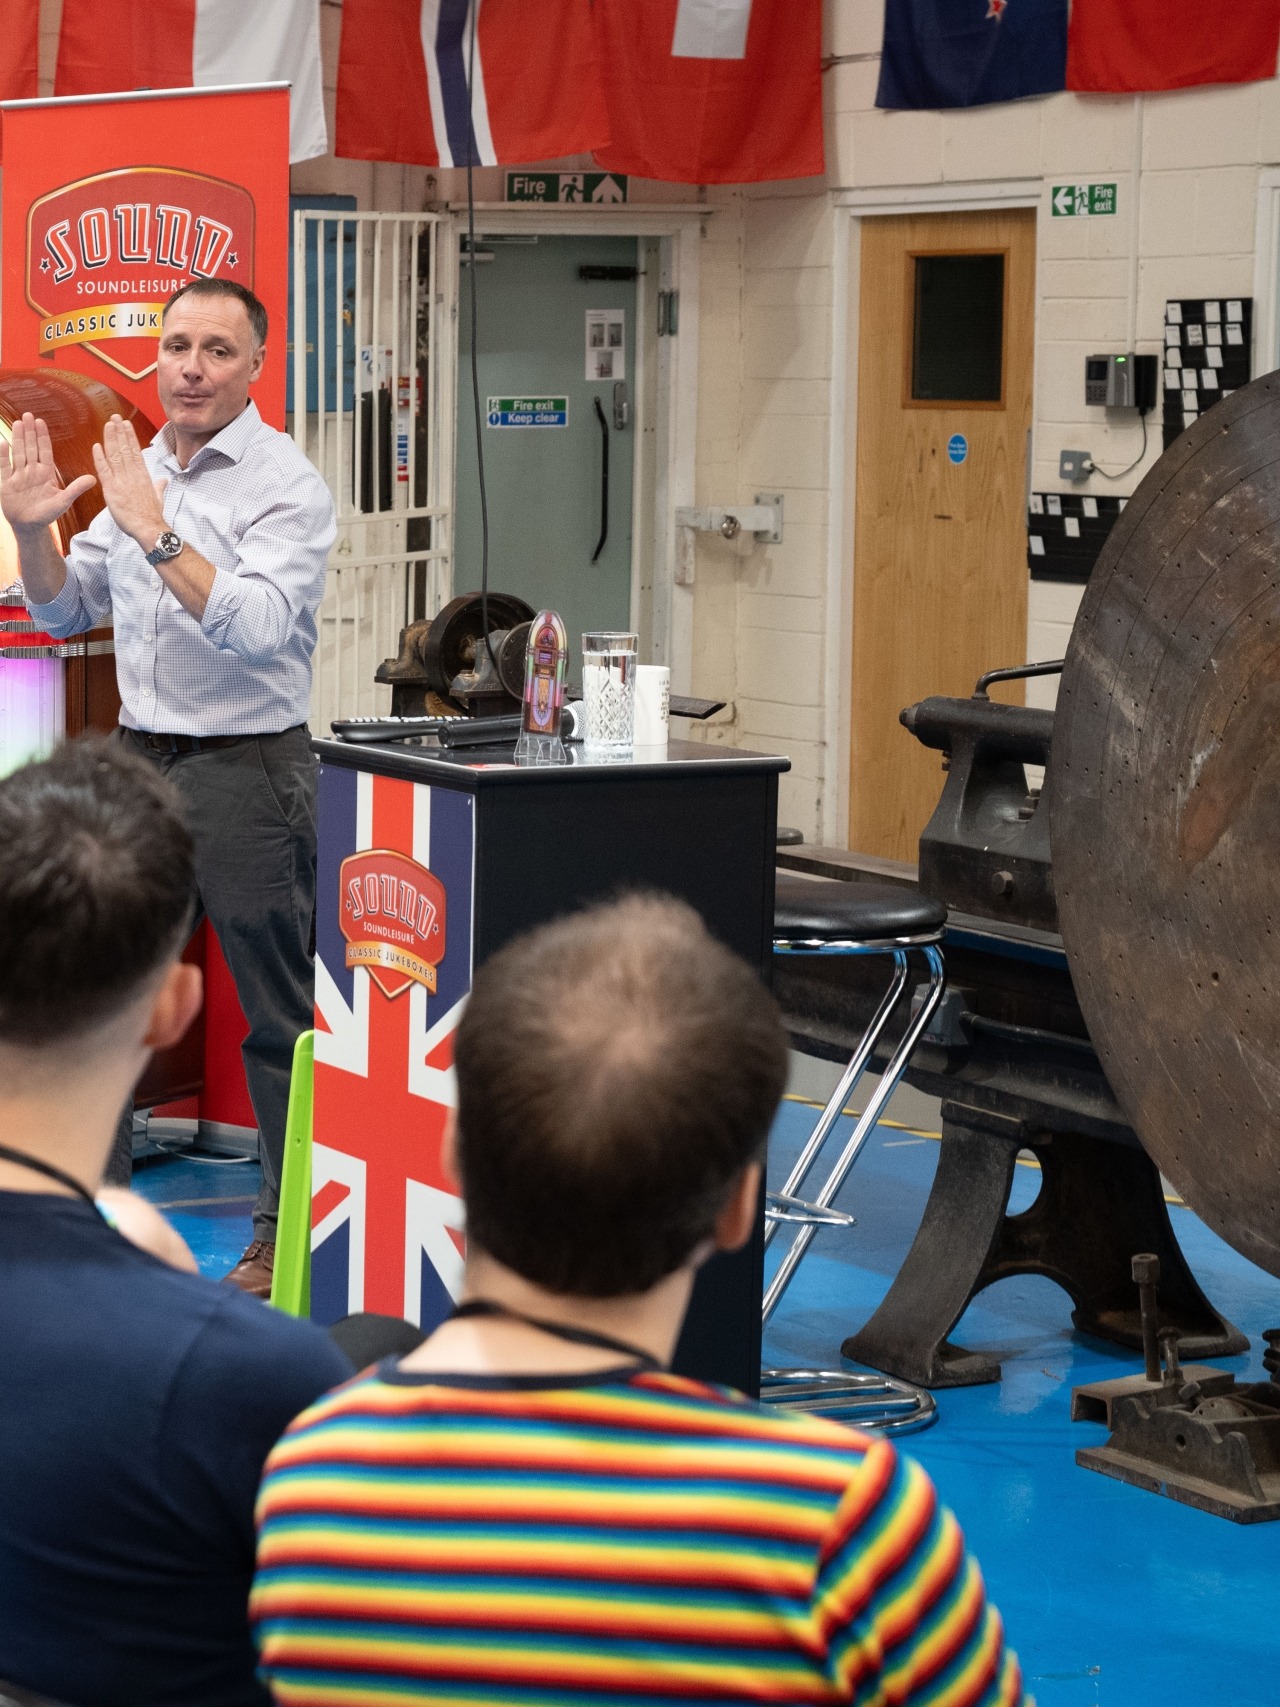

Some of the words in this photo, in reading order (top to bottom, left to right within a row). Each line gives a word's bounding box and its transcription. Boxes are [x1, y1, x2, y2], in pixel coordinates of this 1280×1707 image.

[513, 177, 546, 194] Fire
[1094, 186, 1113, 198] Fire
[1094, 199, 1112, 211] exit
[45, 203, 233, 285] SOUND
[45, 314, 117, 340] CLASSIC
[126, 312, 163, 329] JUK
[513, 400, 533, 411] Fire
[535, 400, 554, 410] exit
[508, 412, 533, 424] Keep
[535, 412, 559, 423] clear
[348, 873, 437, 940] SOUND
[363, 921, 414, 944] SOUNDLEISURE
[348, 947, 381, 959] CLASSIC
[385, 951, 433, 982] JUKEBOXES
